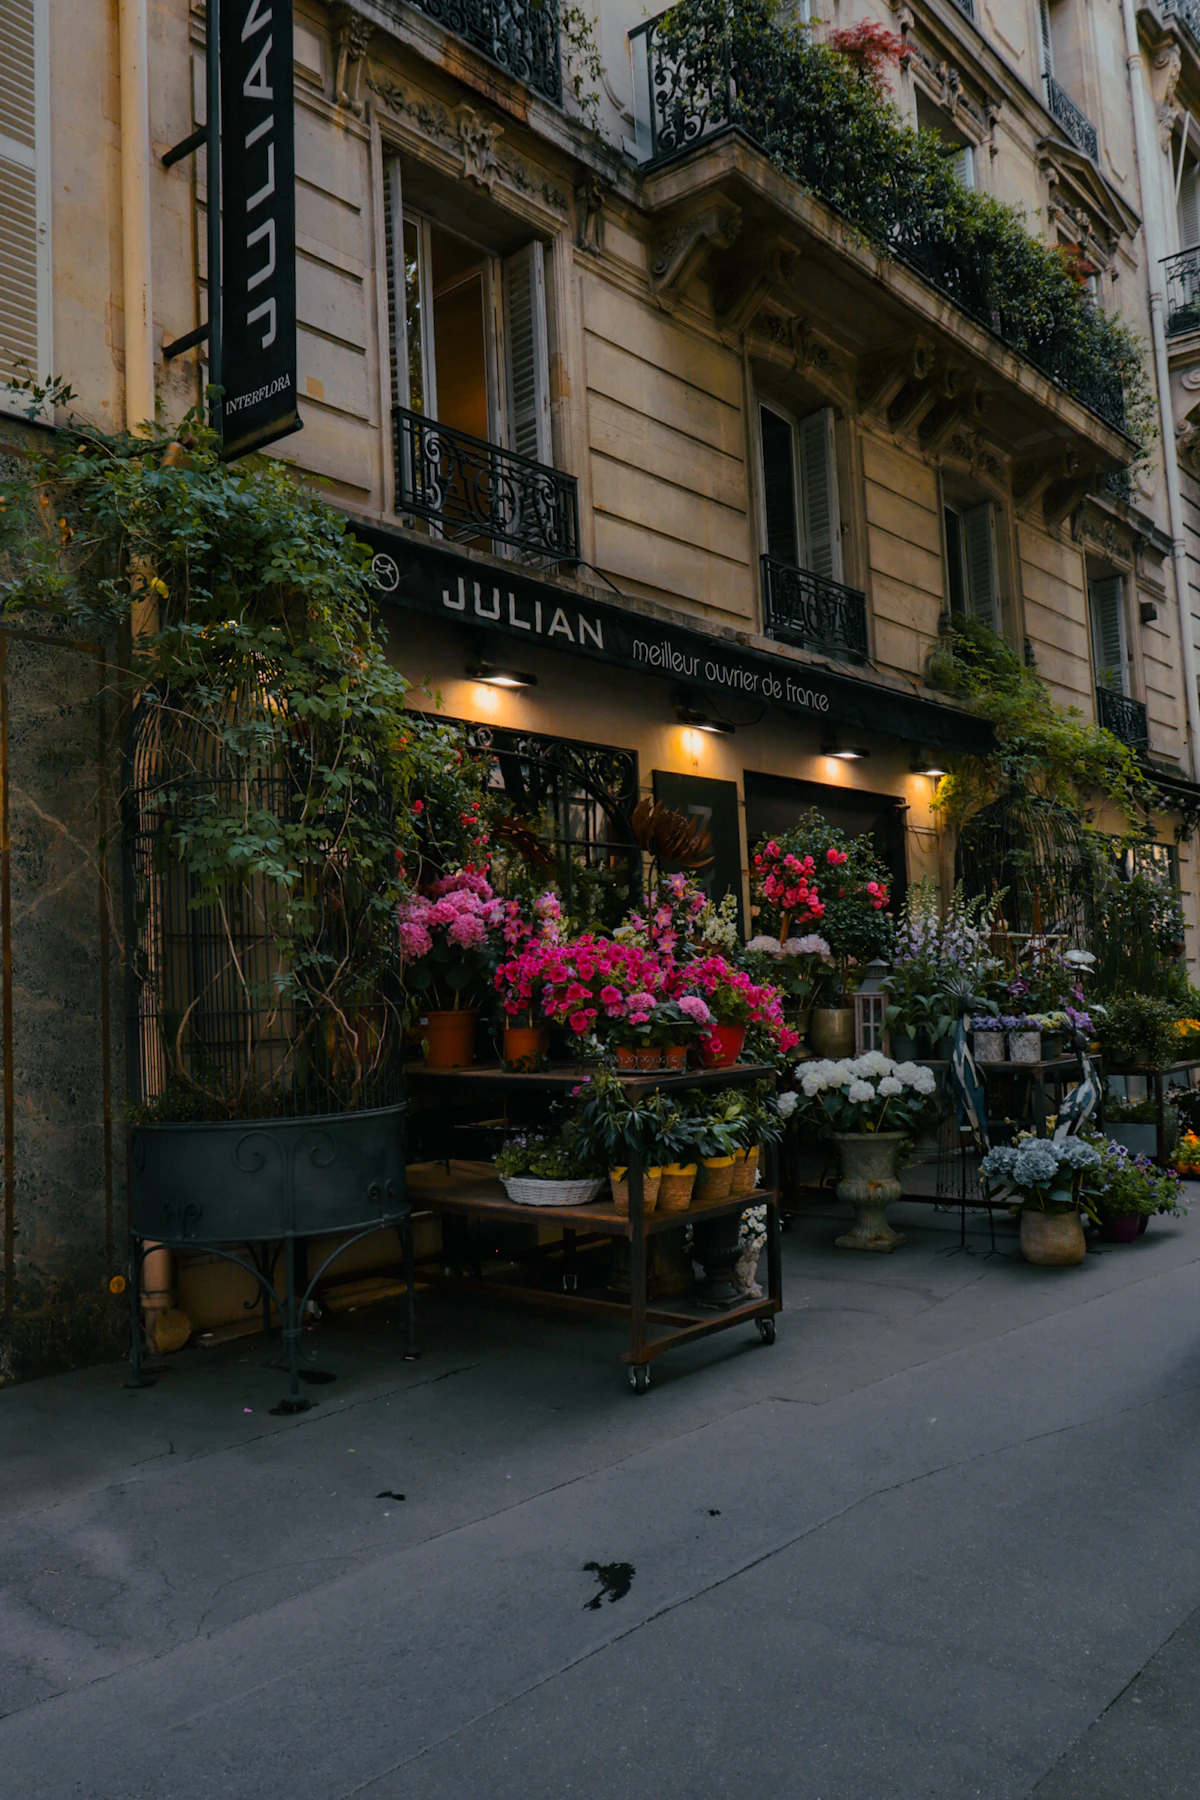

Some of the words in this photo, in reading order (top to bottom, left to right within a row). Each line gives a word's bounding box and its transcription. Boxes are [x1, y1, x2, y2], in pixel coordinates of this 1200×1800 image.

[225, 373, 292, 416] INTERFLORA
[442, 576, 604, 649] JULIAN
[632, 639, 700, 677] meilleur
[704, 661, 758, 692] ouvrier
[761, 672, 782, 699] de
[786, 677, 830, 712] france
